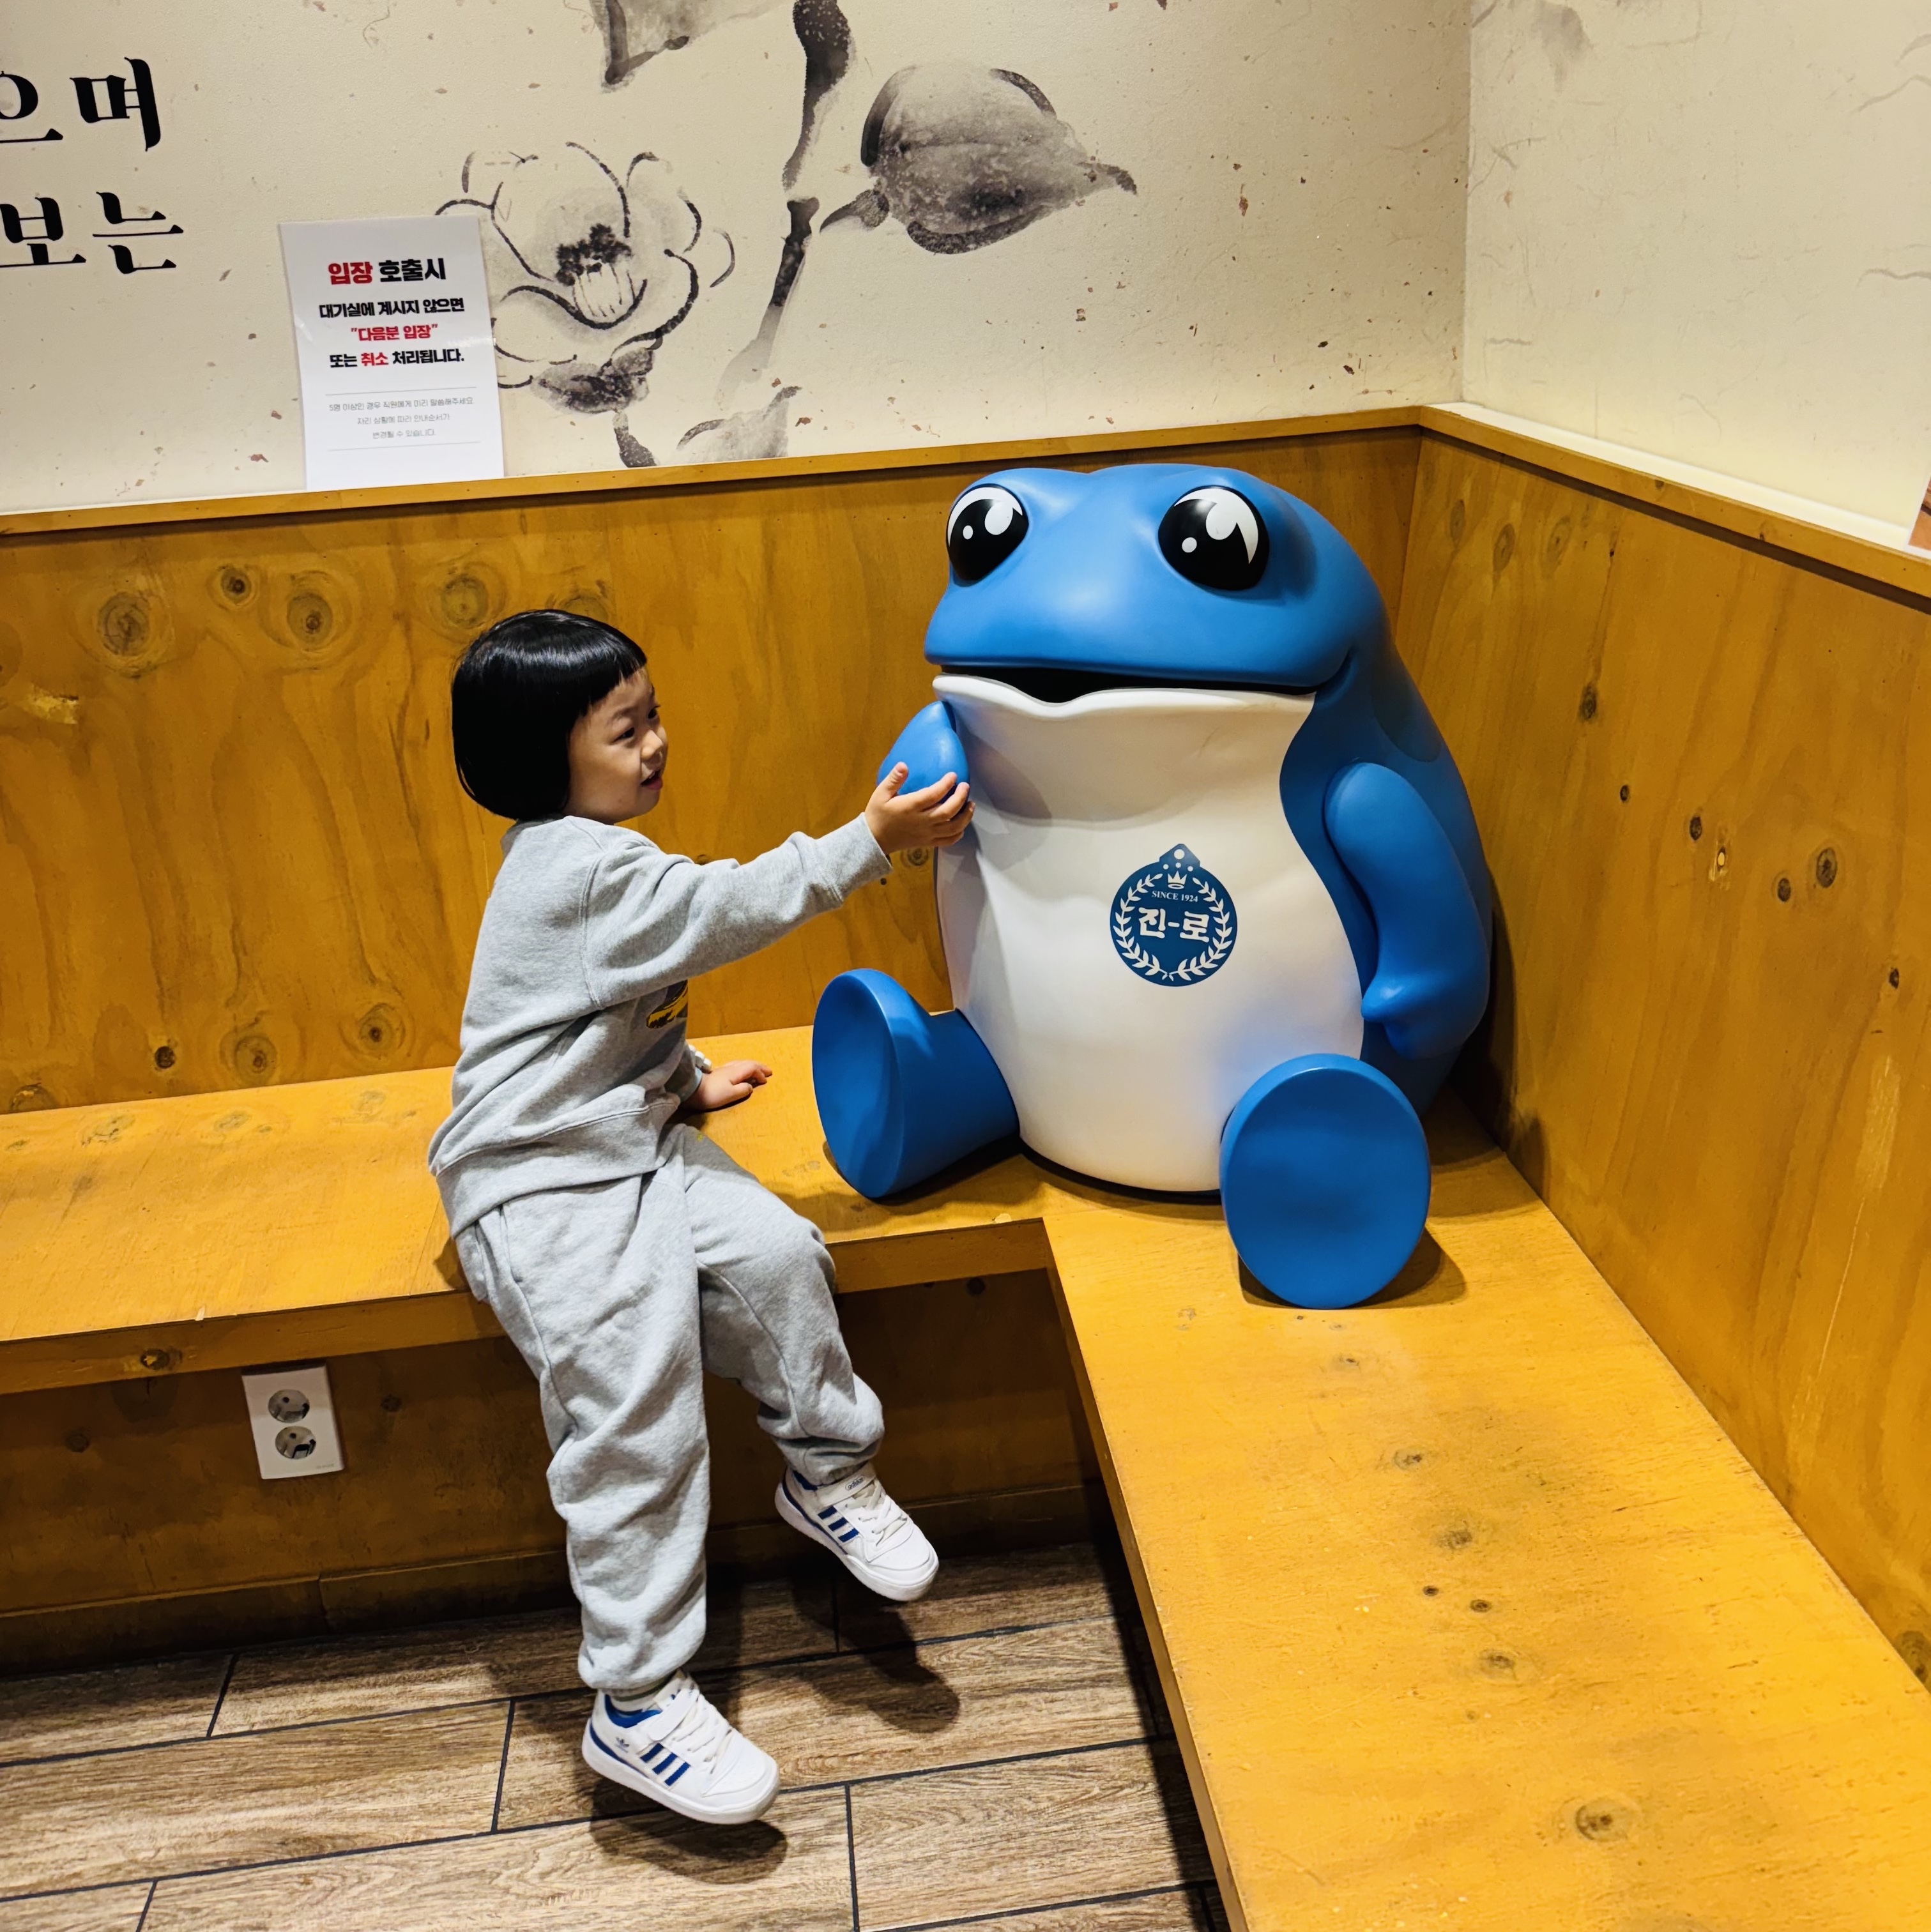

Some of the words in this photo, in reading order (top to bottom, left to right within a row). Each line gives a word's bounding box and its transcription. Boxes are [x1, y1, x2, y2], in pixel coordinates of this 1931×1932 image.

[0, 192, 184, 275] 보는
[328, 261, 373, 285] 입장
[378, 257, 446, 282] 호출시
[319, 302, 375, 318] 대기실에
[378, 300, 420, 316] 계시지
[423, 298, 465, 313] 않으면
[330, 353, 358, 368] 또는
[361, 352, 389, 367] 취소
[392, 348, 464, 365] 처리됩니다.
[342, 402, 364, 411] 이상인
[367, 401, 381, 409] 경우
[383, 400, 412, 409] 직원에게
[413, 399, 428, 407] 미리
[1152, 890, 1179, 901] SINCE
[1181, 894, 1198, 902] 1924
